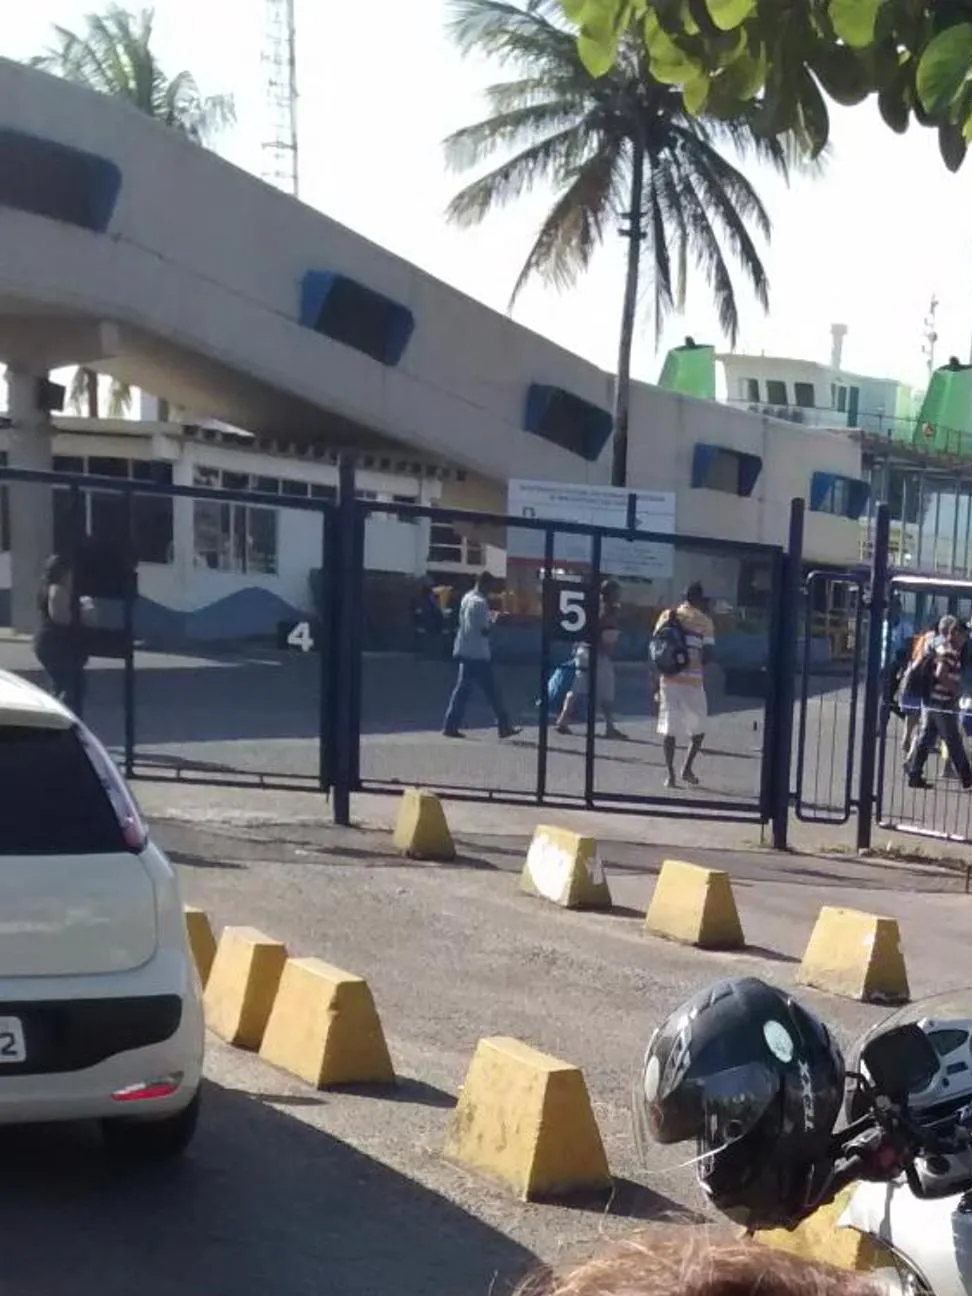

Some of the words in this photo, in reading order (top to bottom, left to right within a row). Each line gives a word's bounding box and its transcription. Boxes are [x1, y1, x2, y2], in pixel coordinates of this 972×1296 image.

[559, 589, 587, 632] 5
[287, 621, 315, 653] 4
[0, 1033, 17, 1056] 2
